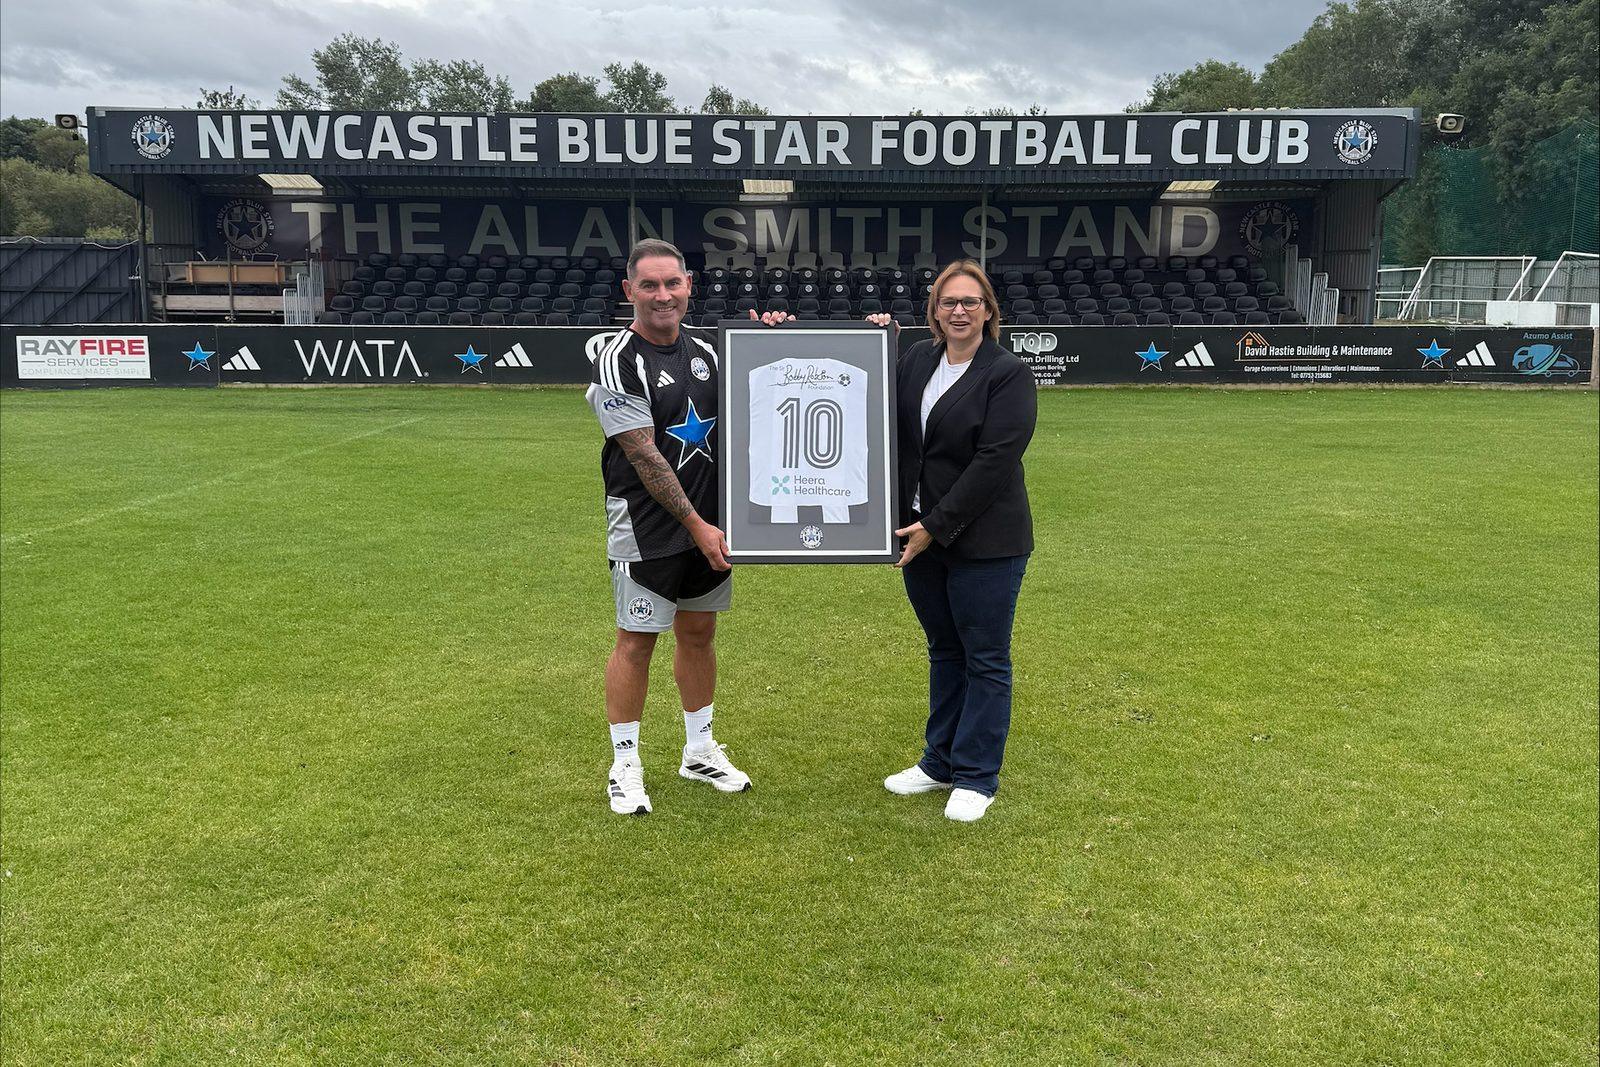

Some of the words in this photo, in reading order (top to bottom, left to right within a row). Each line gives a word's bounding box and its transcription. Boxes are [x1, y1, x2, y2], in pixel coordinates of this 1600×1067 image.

[198, 115, 538, 162] NEWCASTLE
[557, 118, 693, 164] BLUE
[712, 119, 852, 165] STAR
[871, 119, 1152, 166] FOOTBALL
[1170, 118, 1309, 165] CLUB
[291, 202, 445, 256] THE
[468, 204, 675, 257] ALAN
[702, 206, 934, 258] SMITH
[961, 204, 1221, 258] STAND
[1523, 332, 1550, 340] Azumo
[1550, 332, 1574, 340] Assist
[20, 339, 146, 355] RAYFIRE
[1010, 332, 1058, 355] TQD
[1245, 345, 1267, 356] David
[1269, 345, 1295, 356] Hastie
[1296, 345, 1330, 357] Building
[1331, 345, 1339, 356] &
[1340, 345, 1393, 356] Maintenance
[46, 358, 119, 367] SERVICES
[1035, 355, 1064, 365] Drilling
[1066, 355, 1080, 363] Ltd
[21, 368, 83, 376] COMPLIANCE
[84, 368, 111, 376] MADE
[115, 368, 147, 376] SIMPLE
[1244, 365, 1260, 373] Garage
[776, 397, 844, 470] 10
[794, 475, 825, 485] Heera
[794, 485, 851, 497] Healthcare
